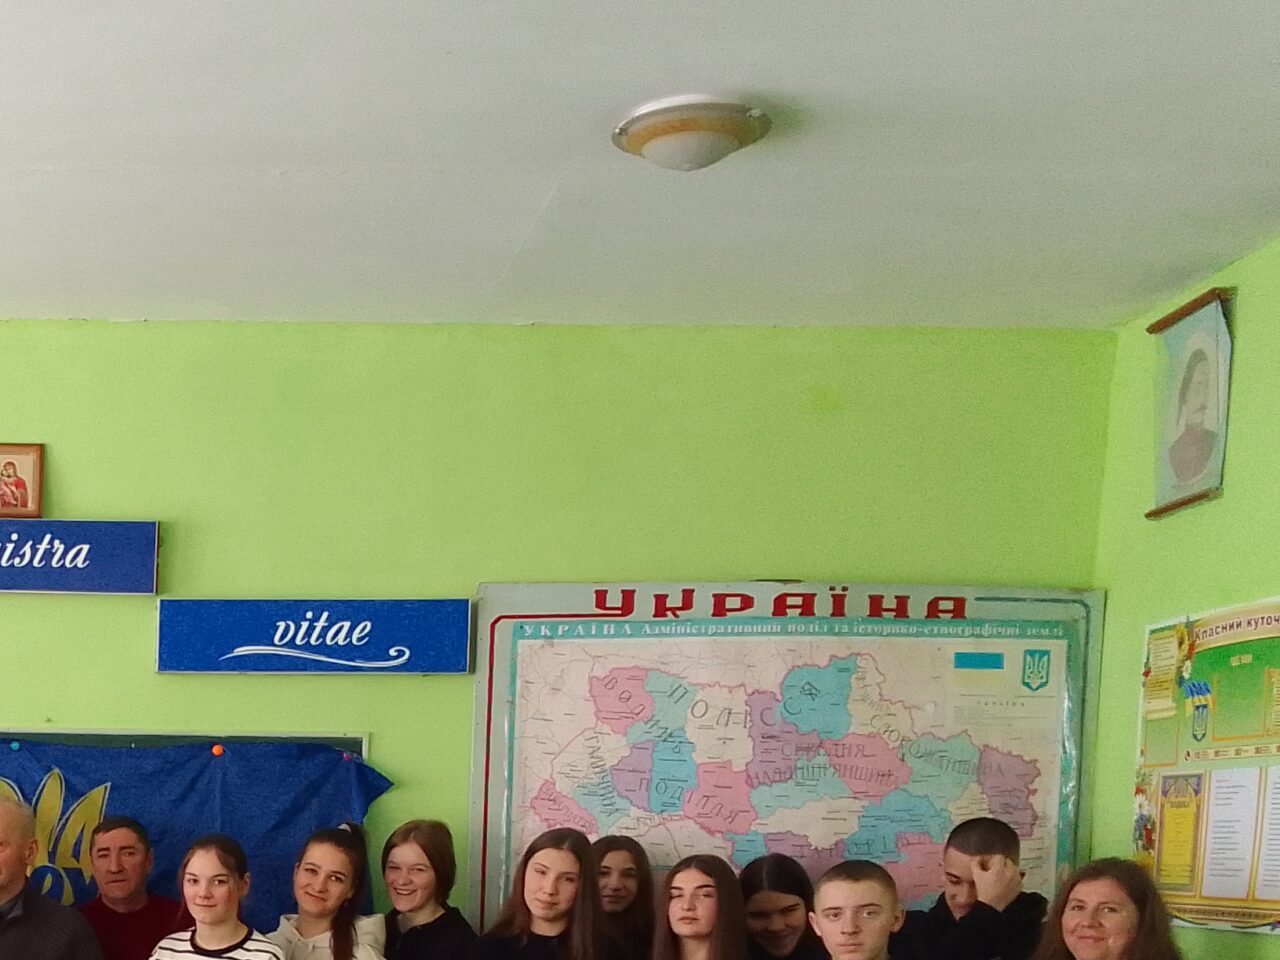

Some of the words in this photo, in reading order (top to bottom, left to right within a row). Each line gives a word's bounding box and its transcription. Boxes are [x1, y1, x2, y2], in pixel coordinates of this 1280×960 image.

[594, 585, 967, 620] УКРАЇНА
[273, 611, 372, 646] vitae
[523, 620, 632, 637] УКРАЇНА
[640, 621, 782, 636] Адміністративний
[1195, 617, 1243, 641] Класний
